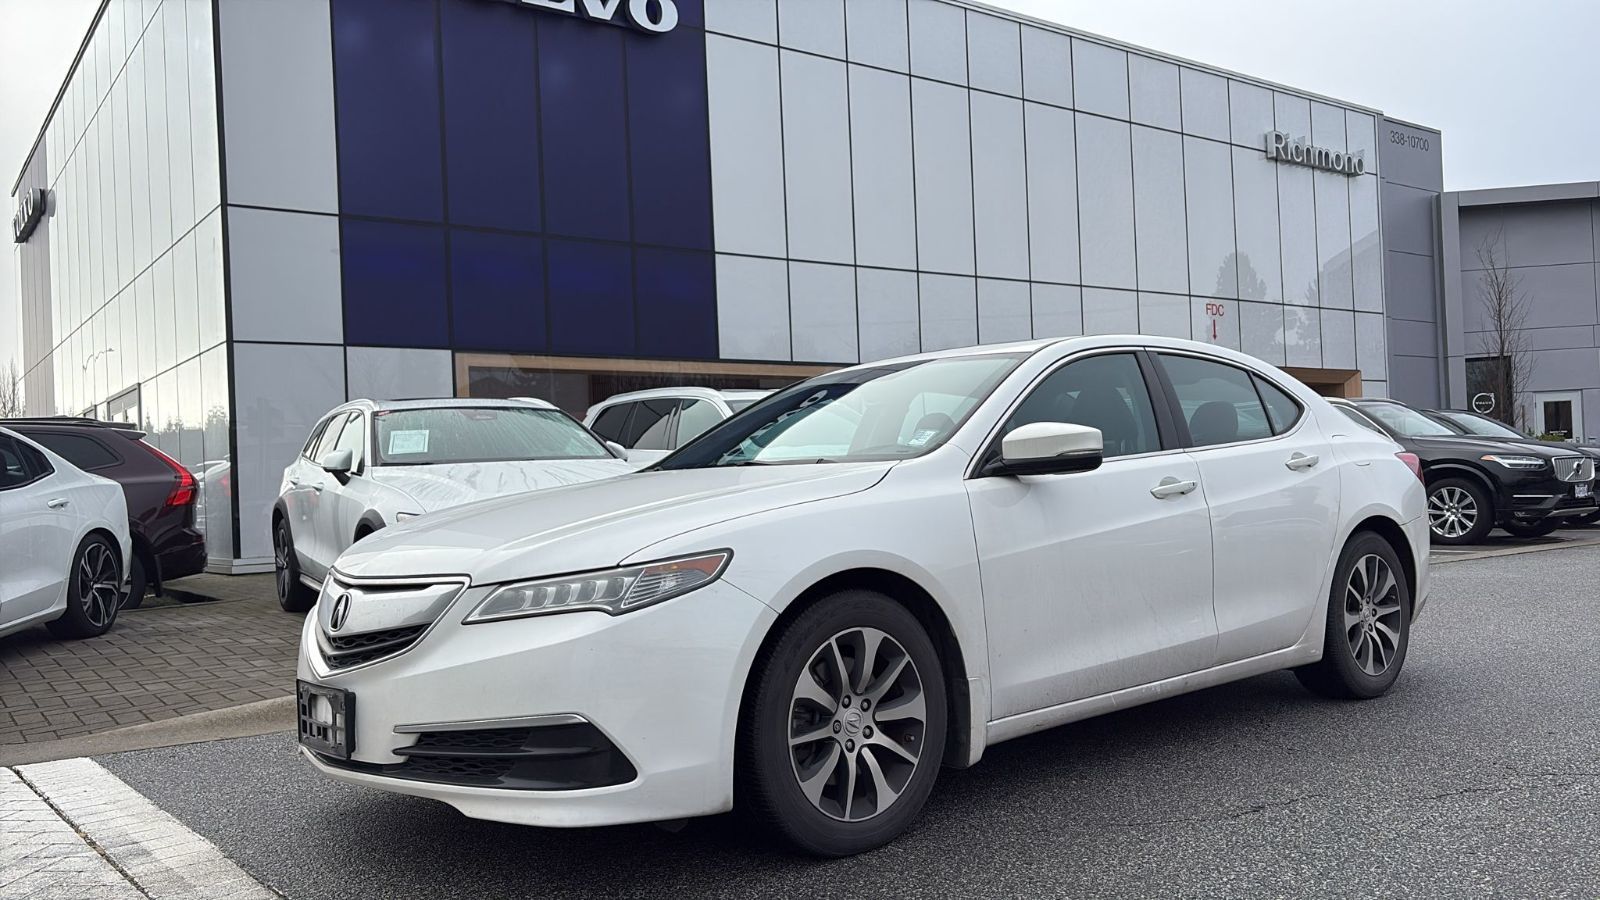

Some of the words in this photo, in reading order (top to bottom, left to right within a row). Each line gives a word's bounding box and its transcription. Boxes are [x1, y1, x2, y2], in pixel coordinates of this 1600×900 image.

[1390, 130, 1429, 151] 338-10700
[1266, 131, 1365, 174] Richmond
[1205, 303, 1225, 317] FDC
